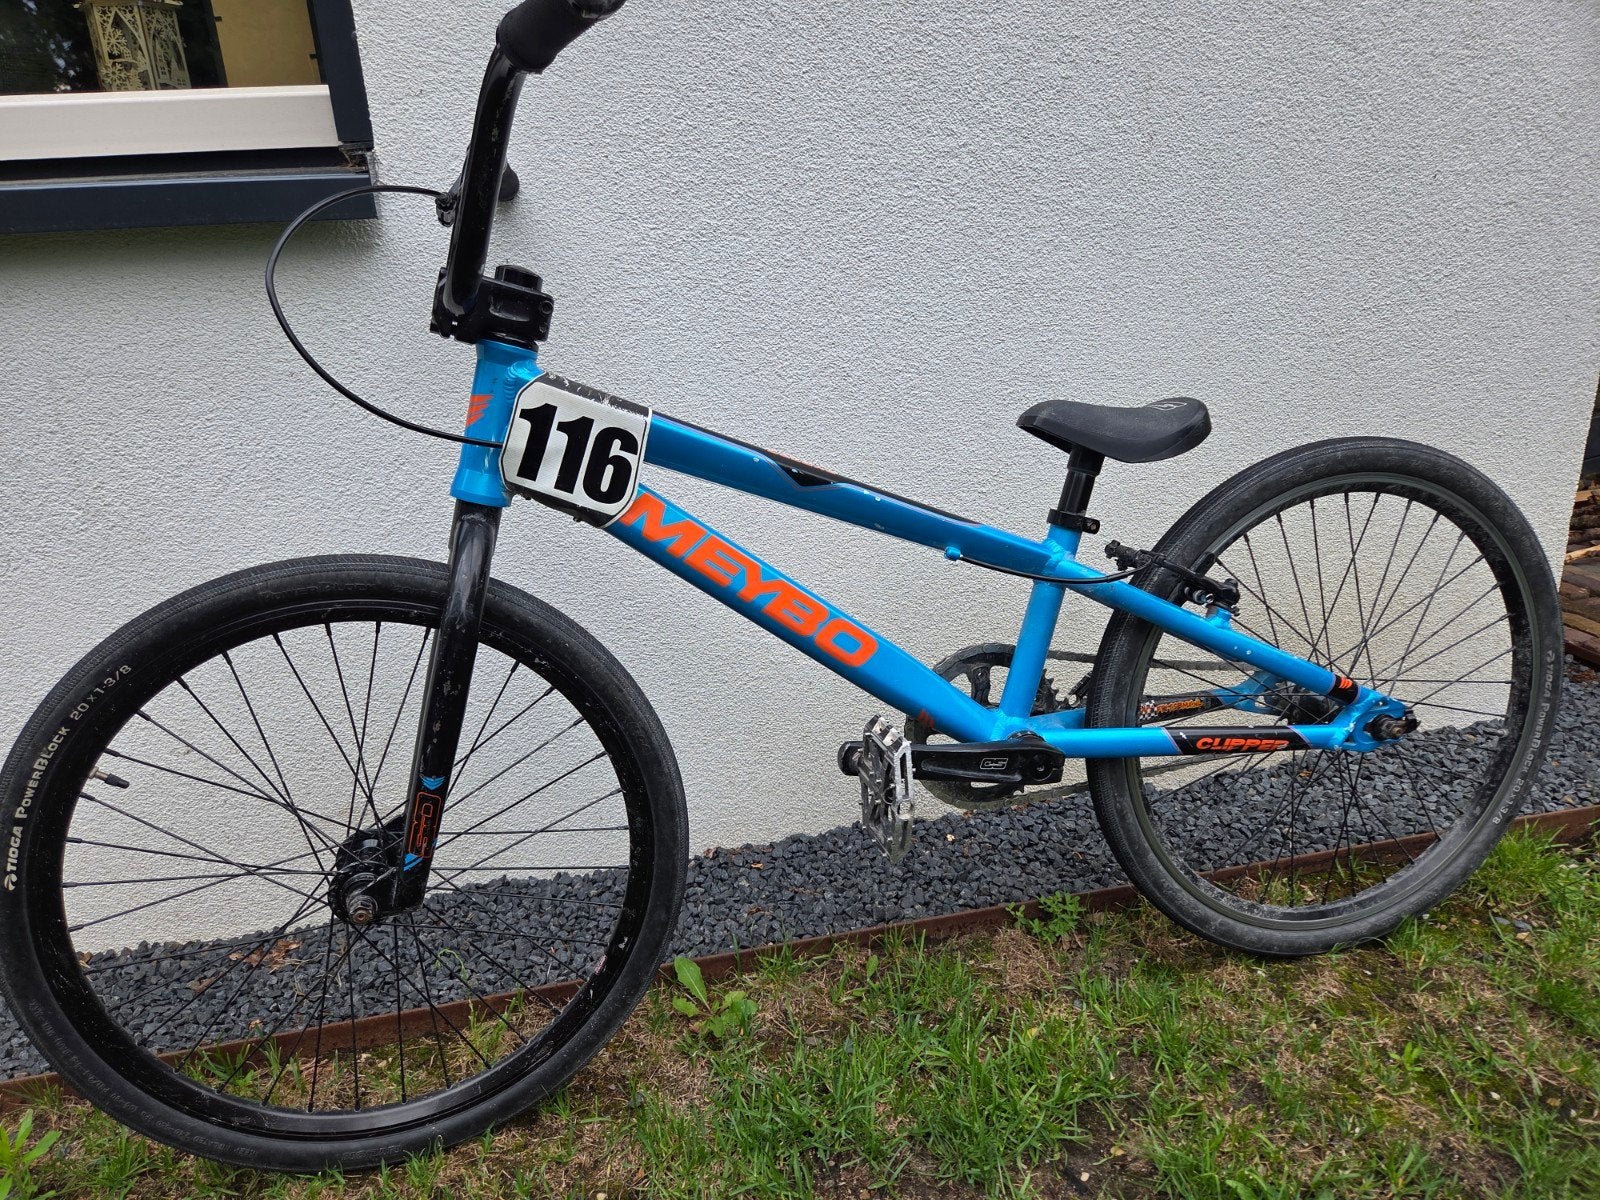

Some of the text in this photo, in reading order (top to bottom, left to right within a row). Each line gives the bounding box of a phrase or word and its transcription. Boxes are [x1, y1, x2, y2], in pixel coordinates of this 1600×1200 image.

[516, 403, 638, 504] 116
[617, 492, 879, 668] MEYBO
[1195, 737, 1290, 751] CLIPPER
[7, 826, 23, 872] TIOGA
